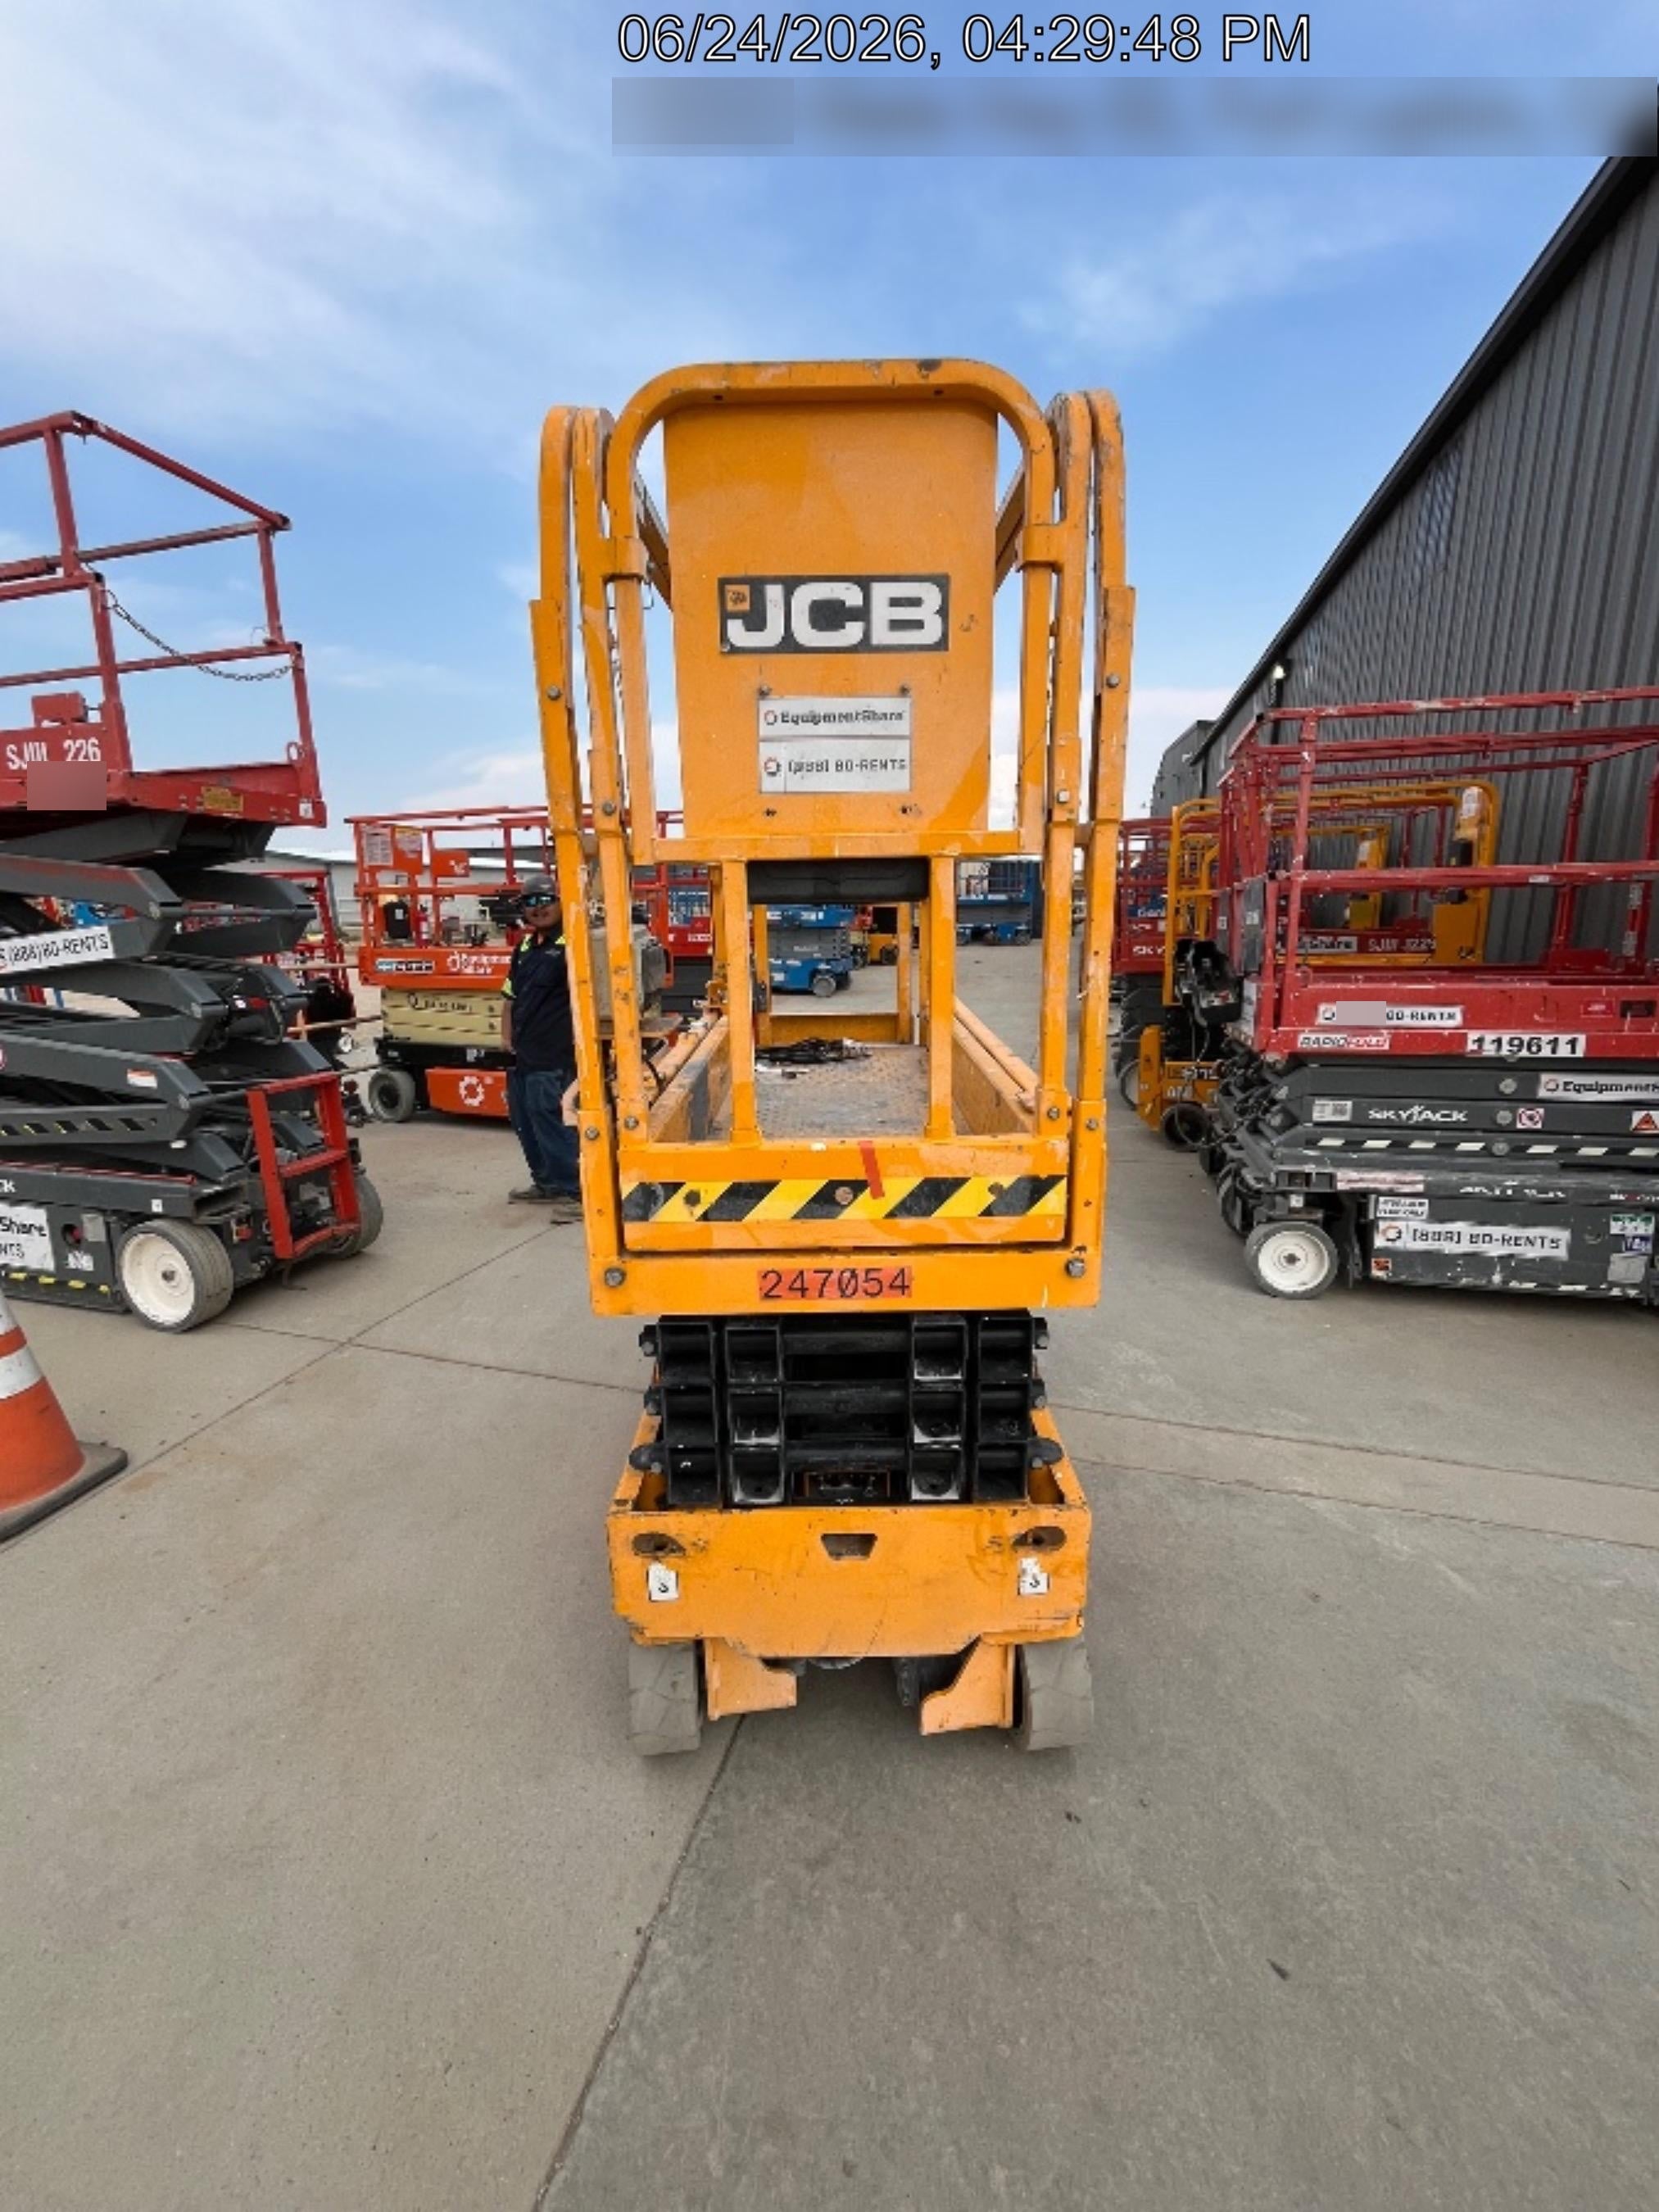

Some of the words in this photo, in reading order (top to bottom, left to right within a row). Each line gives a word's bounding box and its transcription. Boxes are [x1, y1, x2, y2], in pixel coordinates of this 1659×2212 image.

[726, 582, 944, 646] JCB
[1472, 1036, 1580, 1055] 119611
[1367, 1105, 1468, 1124] SKYJACK
[761, 1268, 909, 1299] 247054
